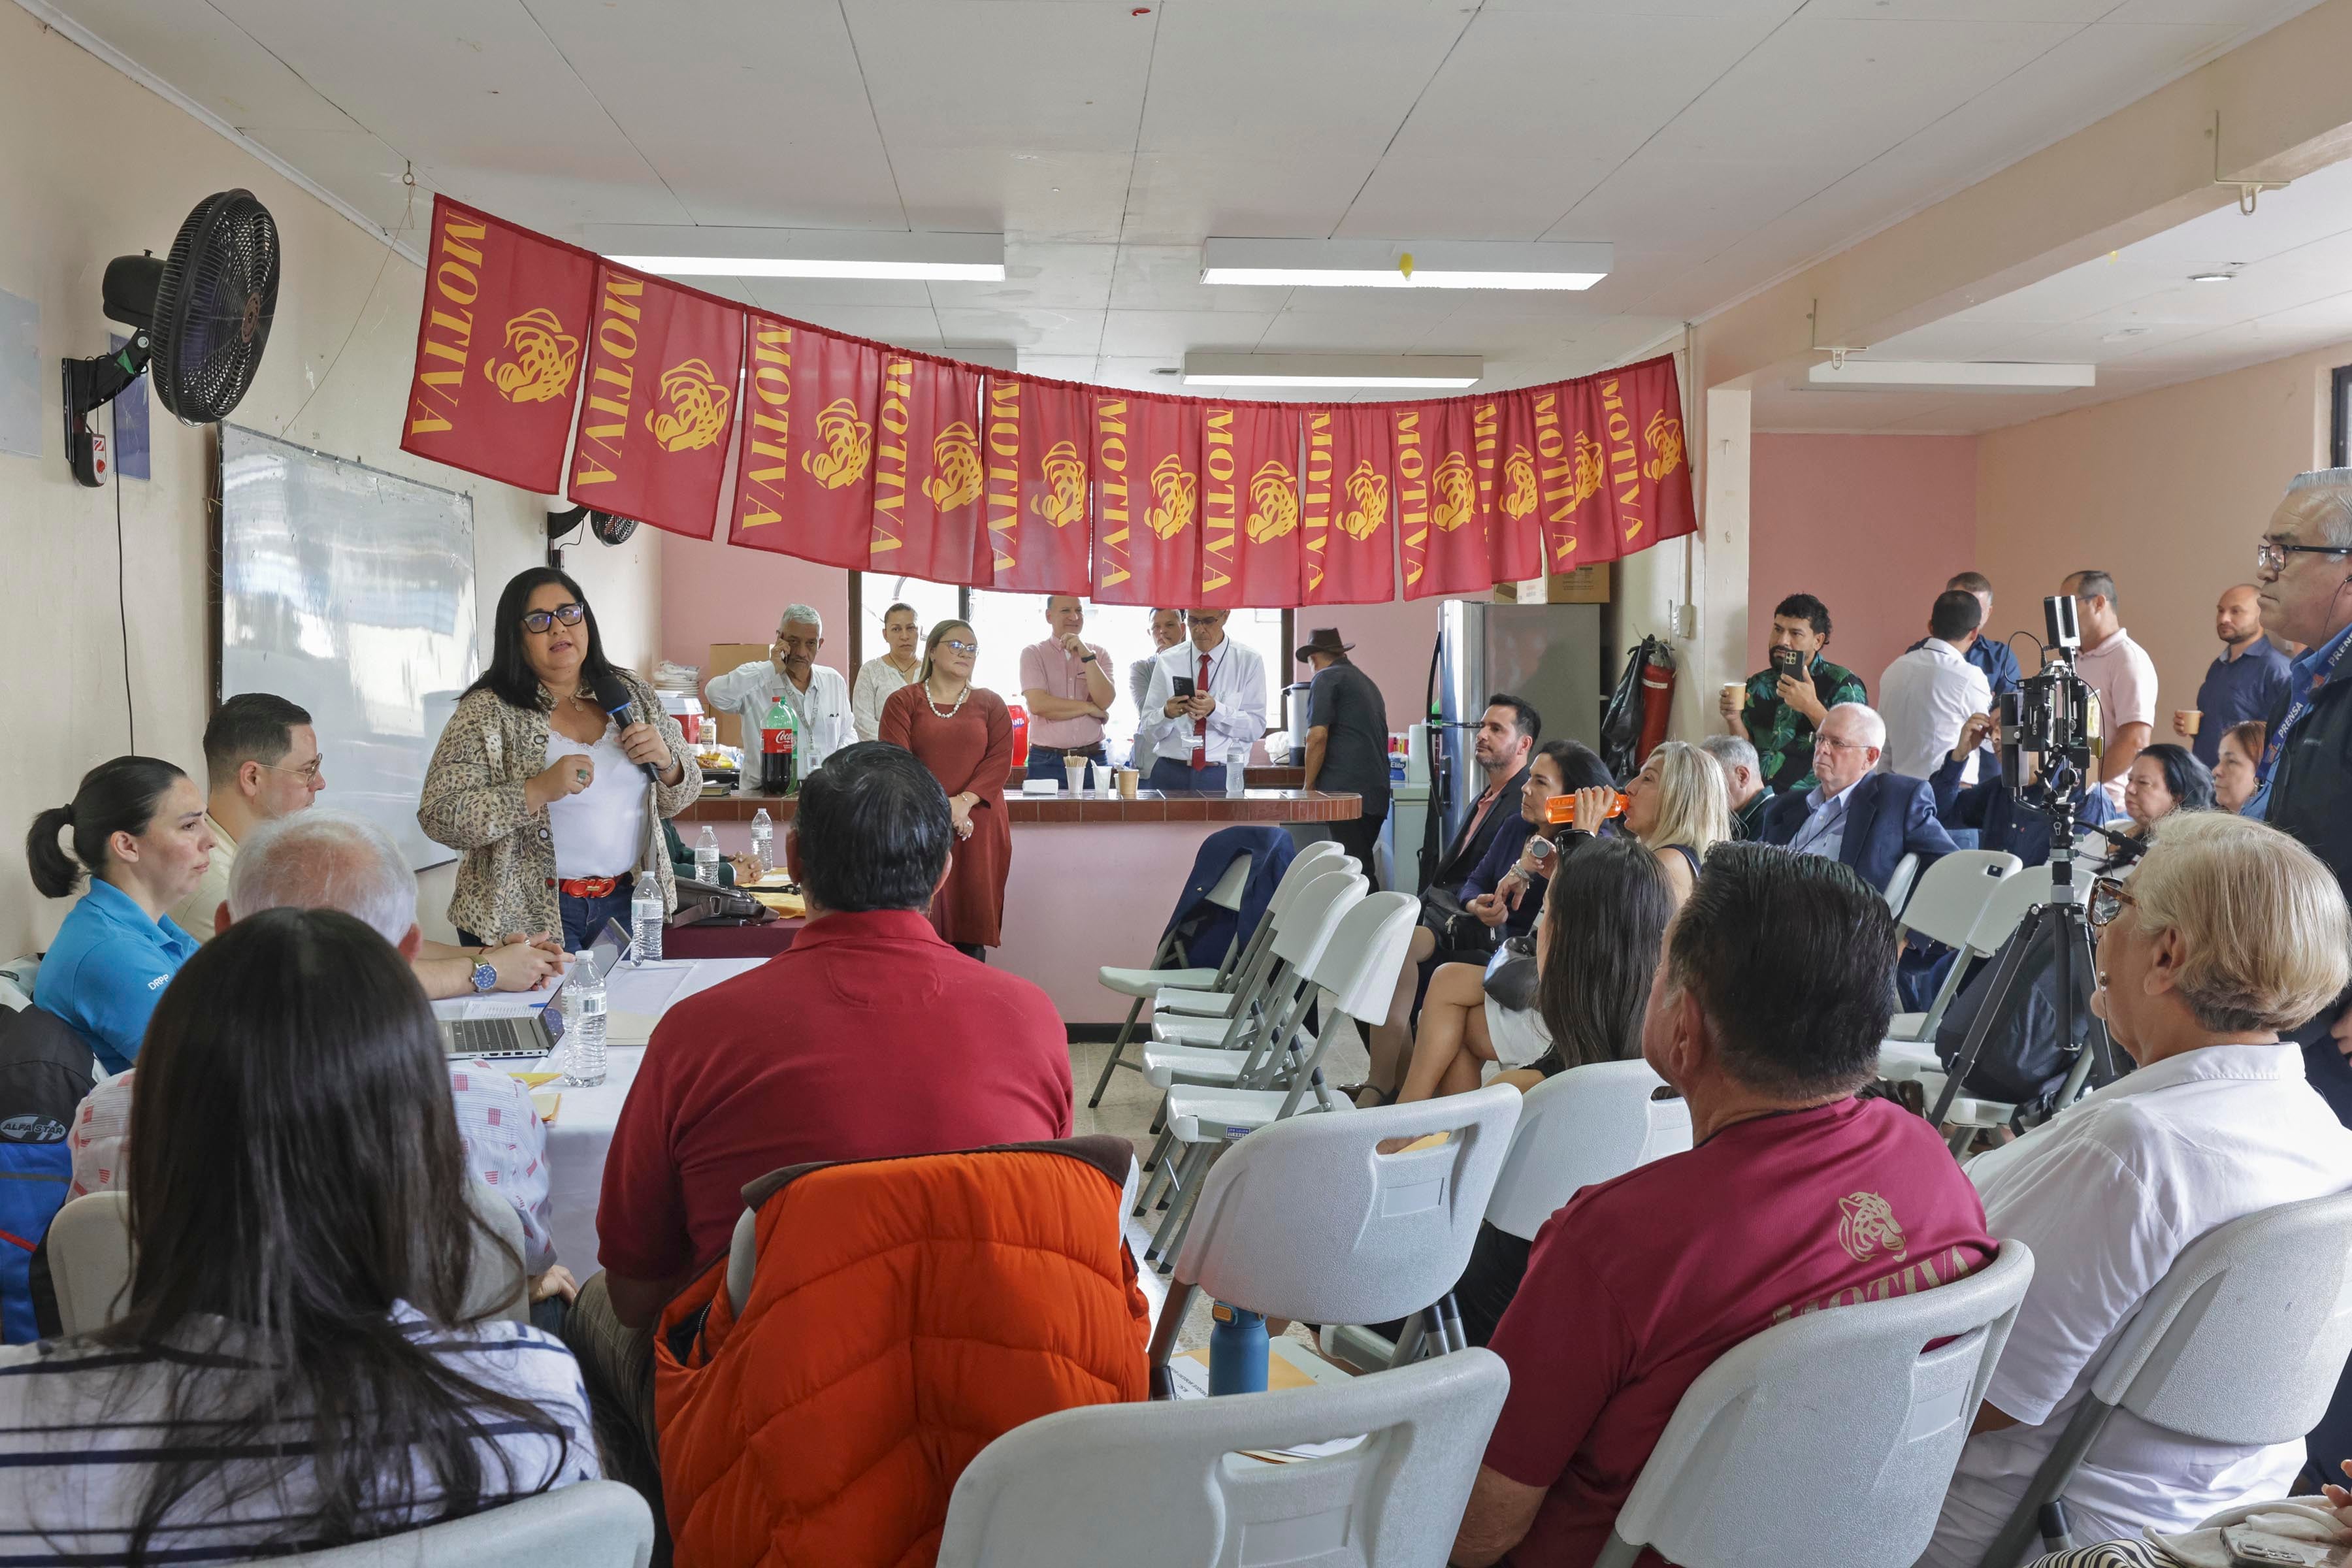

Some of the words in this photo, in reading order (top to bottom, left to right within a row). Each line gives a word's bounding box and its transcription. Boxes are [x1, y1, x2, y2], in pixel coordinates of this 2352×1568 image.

[411, 209, 487, 436] MOTIVA
[576, 271, 644, 487] MOTIVA
[742, 318, 792, 531] MOTIVA
[870, 353, 913, 554] MOTIVA
[987, 378, 1020, 572] MOTIVA
[1098, 396, 1131, 590] MOTIVA
[1201, 406, 1235, 593] MOTIVA
[1305, 412, 1333, 592] MOTIVA
[1396, 410, 1429, 587] MOTIVA
[1533, 393, 1577, 560] MOTIVA
[1598, 378, 1644, 543] MOTIVA
[2278, 702, 2303, 739] PRENSA
[148, 973, 169, 990] DRPP
[3, 1123, 33, 1132] ALFA
[33, 1124, 63, 1135] STAR
